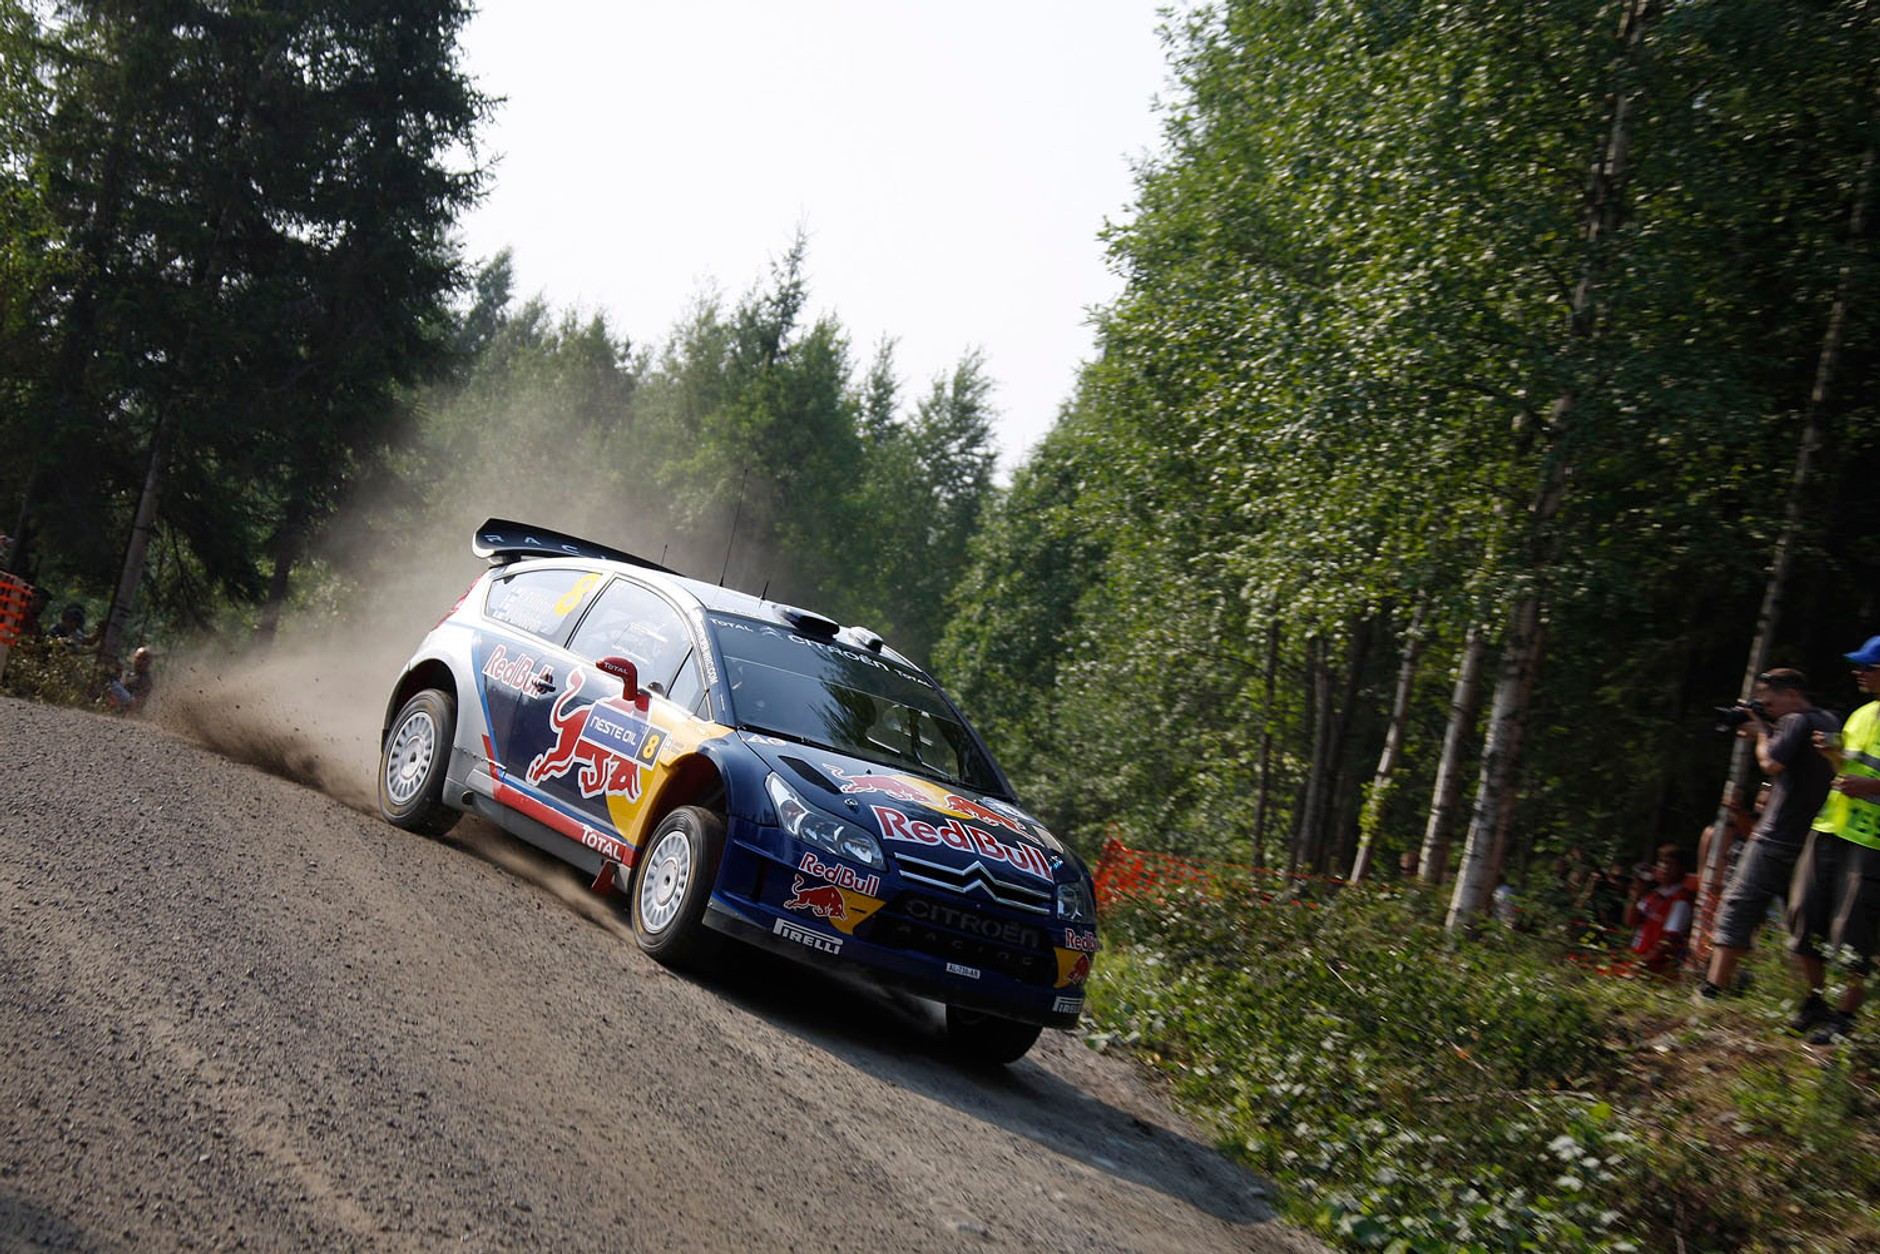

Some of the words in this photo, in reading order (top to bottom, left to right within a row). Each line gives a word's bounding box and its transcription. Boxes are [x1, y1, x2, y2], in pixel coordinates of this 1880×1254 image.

[553, 573, 602, 617] 8
[709, 618, 754, 633] TOTAL
[604, 661, 629, 675] TOTAL
[590, 715, 625, 740] NESTE
[642, 735, 660, 759] 8
[581, 824, 622, 861] TOTAL
[773, 917, 844, 955] PIRELLI
